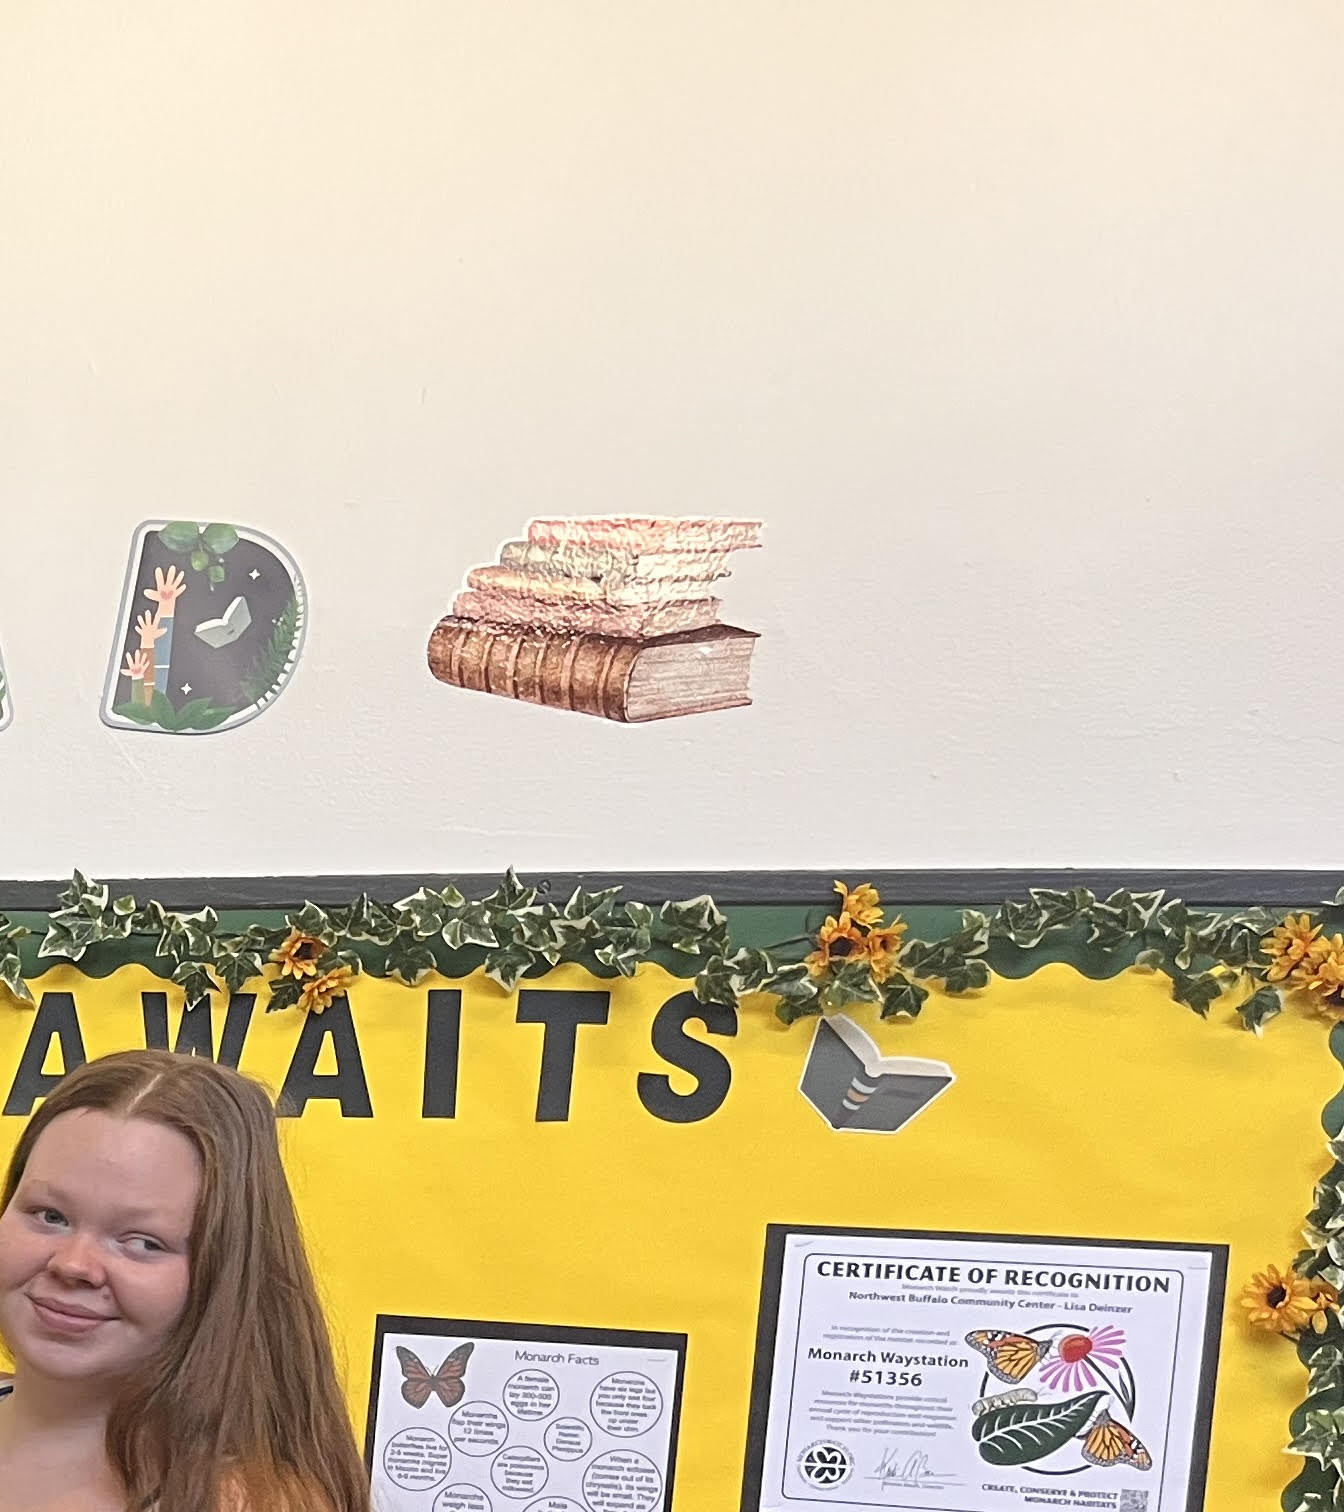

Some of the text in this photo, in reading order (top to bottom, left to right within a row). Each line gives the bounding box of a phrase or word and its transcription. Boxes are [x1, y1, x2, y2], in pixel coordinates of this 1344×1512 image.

[2, 990, 740, 1122] AWAITS
[817, 1261, 1170, 1293] CERTIFICATE OF RECOGNITION
[849, 1291, 905, 1303] Northwest
[908, 1293, 948, 1305] Buffalo
[951, 1296, 1015, 1309] Community
[1017, 1299, 1056, 1310] Center
[1064, 1301, 1086, 1312] Lisa
[514, 1350, 600, 1366] Monarch Facts
[808, 1348, 969, 1368] Monarch Waystation
[849, 1370, 923, 1387] #51356
